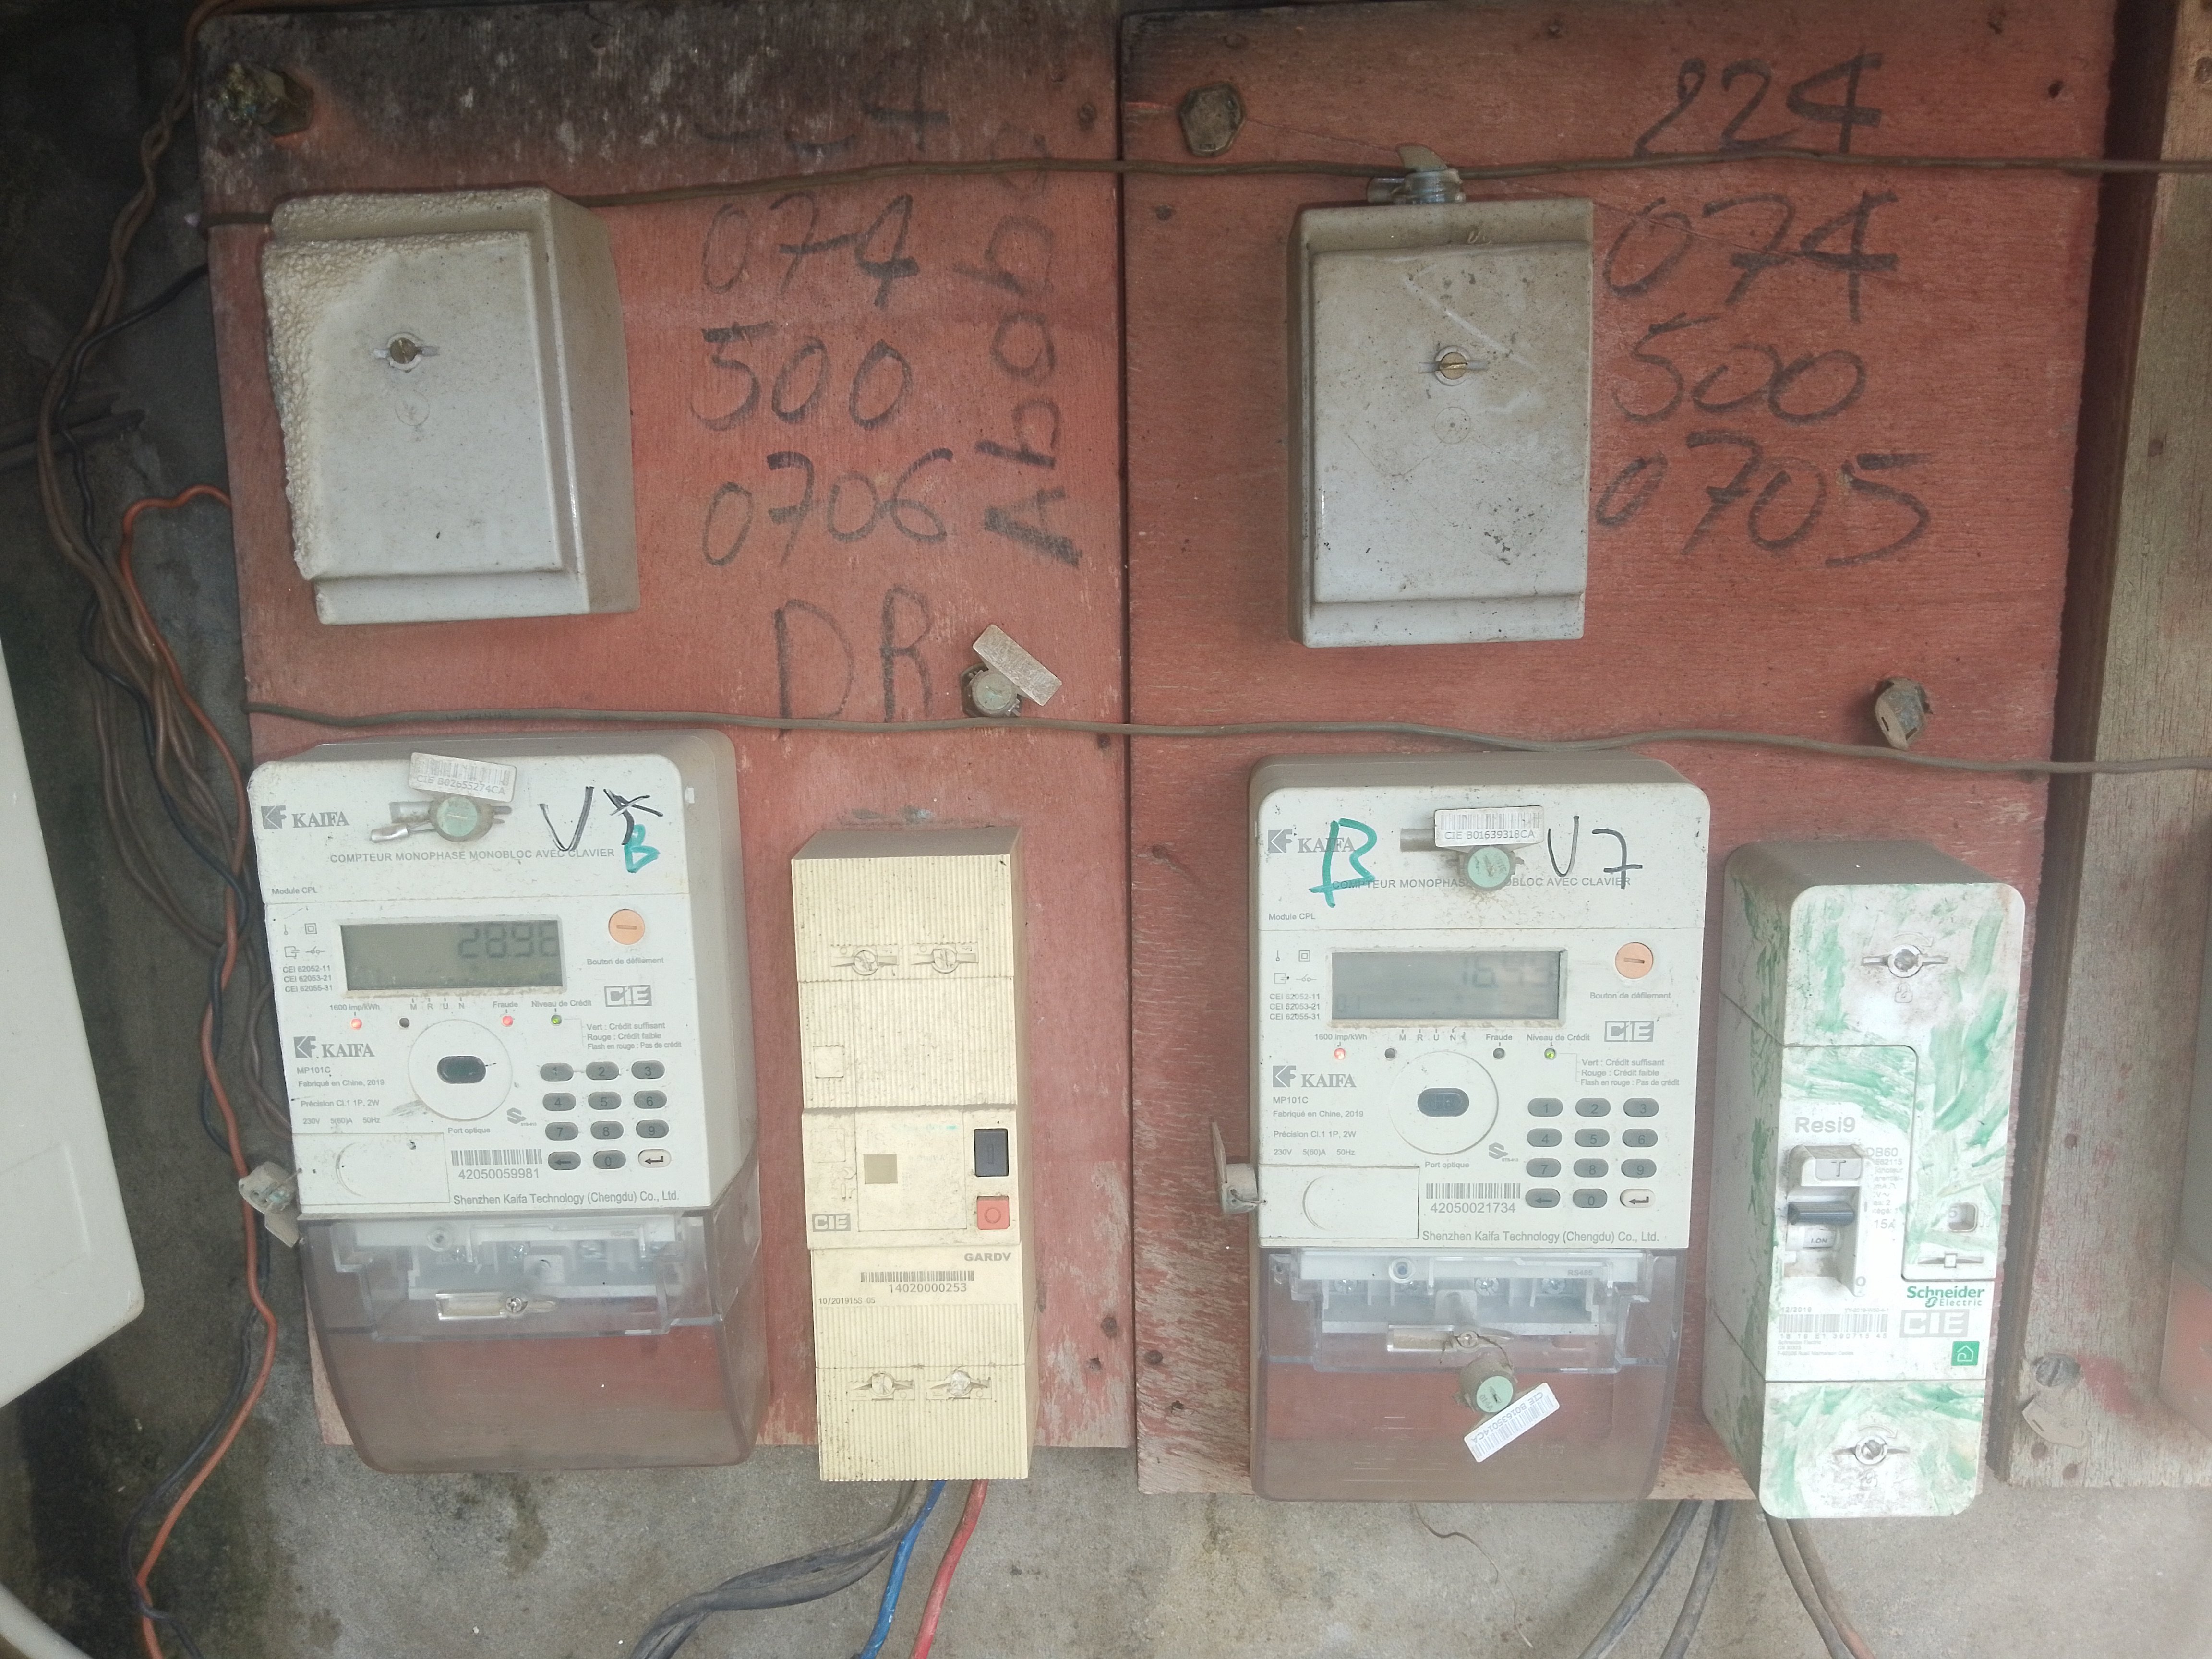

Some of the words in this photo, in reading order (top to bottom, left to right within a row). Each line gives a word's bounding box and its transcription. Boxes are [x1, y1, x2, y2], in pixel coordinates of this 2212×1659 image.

[1635, 46, 1883, 156] 224
[702, 192, 918, 308] 074
[1603, 191, 1898, 324] 074
[1612, 312, 1867, 426] 500
[690, 320, 913, 431] 500
[1595, 430, 1934, 568] 0705
[702, 447, 953, 566] 0706
[417, 775, 434, 785] CIE
[291, 811, 350, 828] KAIFA
[1444, 831, 1463, 840] CIE
[1466, 830, 1535, 840] B01639318CA
[1298, 836, 1356, 853] KAIFA
[330, 853, 392, 863] COMPTEUR
[395, 851, 466, 862] MONOPHASE
[470, 850, 531, 860] MONOBLOC
[536, 850, 565, 859] AVEC
[569, 848, 615, 858] CLAVIER
[1332, 879, 1396, 889] COMPTEUR
[1547, 878, 1578, 887] AVEC
[1581, 877, 1631, 887] CLAVIER
[298, 965, 331, 973] 62052-11
[299, 974, 332, 983] 62053-21
[300, 985, 333, 993] 62055-31
[604, 985, 652, 1007] CIE
[349, 1003, 380, 1012] imp/kWh
[1335, 1033, 1367, 1042] imp/kWh
[1604, 1021, 1654, 1042] CIE
[587, 1034, 612, 1042] Rouge
[322, 1043, 375, 1057] KAIFA
[297, 1066, 331, 1074] MP101C
[1581, 1069, 1607, 1078] Rouge
[298, 1080, 329, 1089] Fabriqué
[342, 1079, 365, 1087] Chine,
[1301, 1073, 1357, 1088] KAIFA
[301, 1099, 334, 1107] Précision
[367, 1098, 380, 1106] 2W
[1273, 1110, 1305, 1118] Fabriqué
[1319, 1110, 1343, 1118] Chine,
[330, 1117, 353, 1126] 5(60)A
[1795, 1116, 1856, 1134] Resi9
[465, 1127, 491, 1136] optique
[1302, 1149, 1326, 1157] 5(60)A
[1867, 1147, 1898, 1157] DB60
[1442, 1161, 1469, 1170] optique
[458, 1168, 540, 1180] 42050059981
[453, 1194, 501, 1205] Shenzhen
[504, 1193, 528, 1204] Kaifa
[529, 1192, 584, 1205] Technology
[587, 1191, 637, 1204] (Chengdu)
[640, 1191, 660, 1202] Co.,
[662, 1190, 680, 1201] Ltd.
[1430, 1202, 1516, 1214] 42050021734
[812, 1213, 851, 1232] CIE
[1422, 1231, 1472, 1242] Shenzhen
[1475, 1231, 1500, 1242] Kaifa
[1503, 1231, 1560, 1244] Technology
[1562, 1230, 1615, 1243] (Chengdu)
[1618, 1231, 1638, 1243] Co.,
[1640, 1231, 1659, 1242] Ltd.
[888, 1283, 967, 1293] 14020000253
[1907, 1286, 1985, 1298] Schneider
[1899, 1309, 1970, 1338] CIE
[1528, 1392, 1544, 1406] CIE
[1470, 1403, 1527, 1443] B01635014CA
